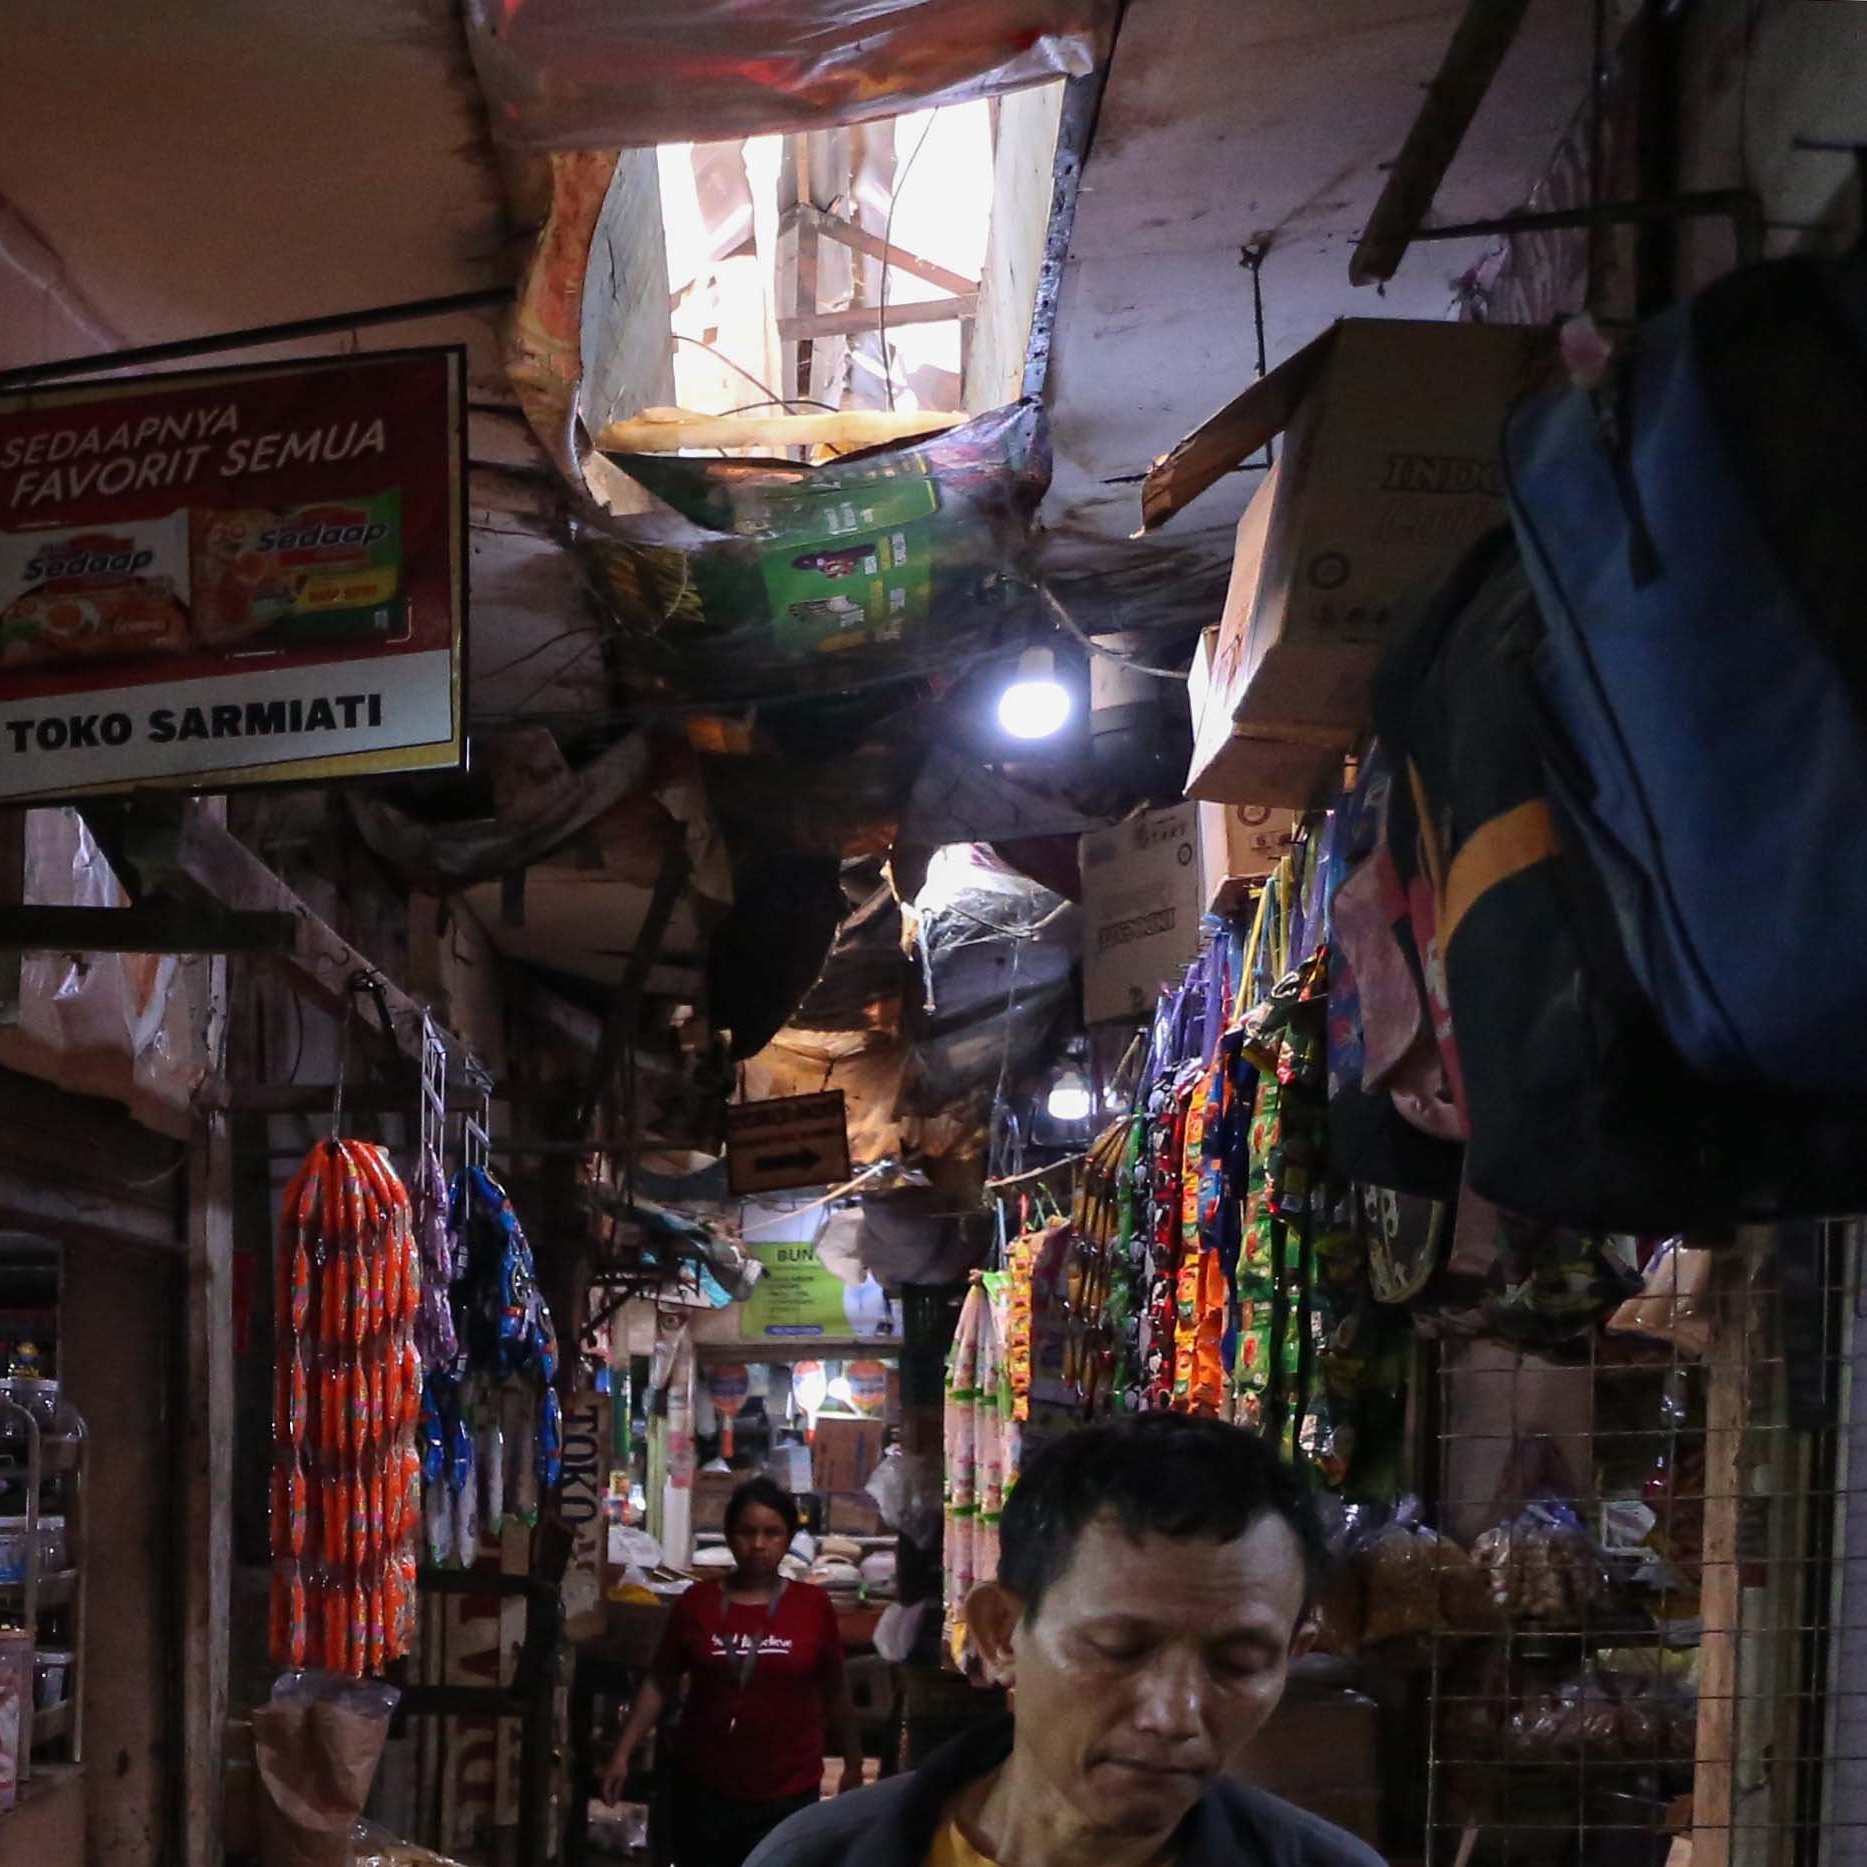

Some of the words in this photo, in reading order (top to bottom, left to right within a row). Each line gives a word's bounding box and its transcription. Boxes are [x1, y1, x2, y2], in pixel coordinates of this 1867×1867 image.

[9, 444, 209, 508] FAVORIT
[219, 418, 386, 478] SEMUA
[21, 548, 154, 582] Sedaap
[258, 518, 388, 553] Sedaap
[6, 713, 132, 752] TOKO
[147, 692, 383, 744] SARMIATI
[560, 1404, 599, 1524] TOKO
